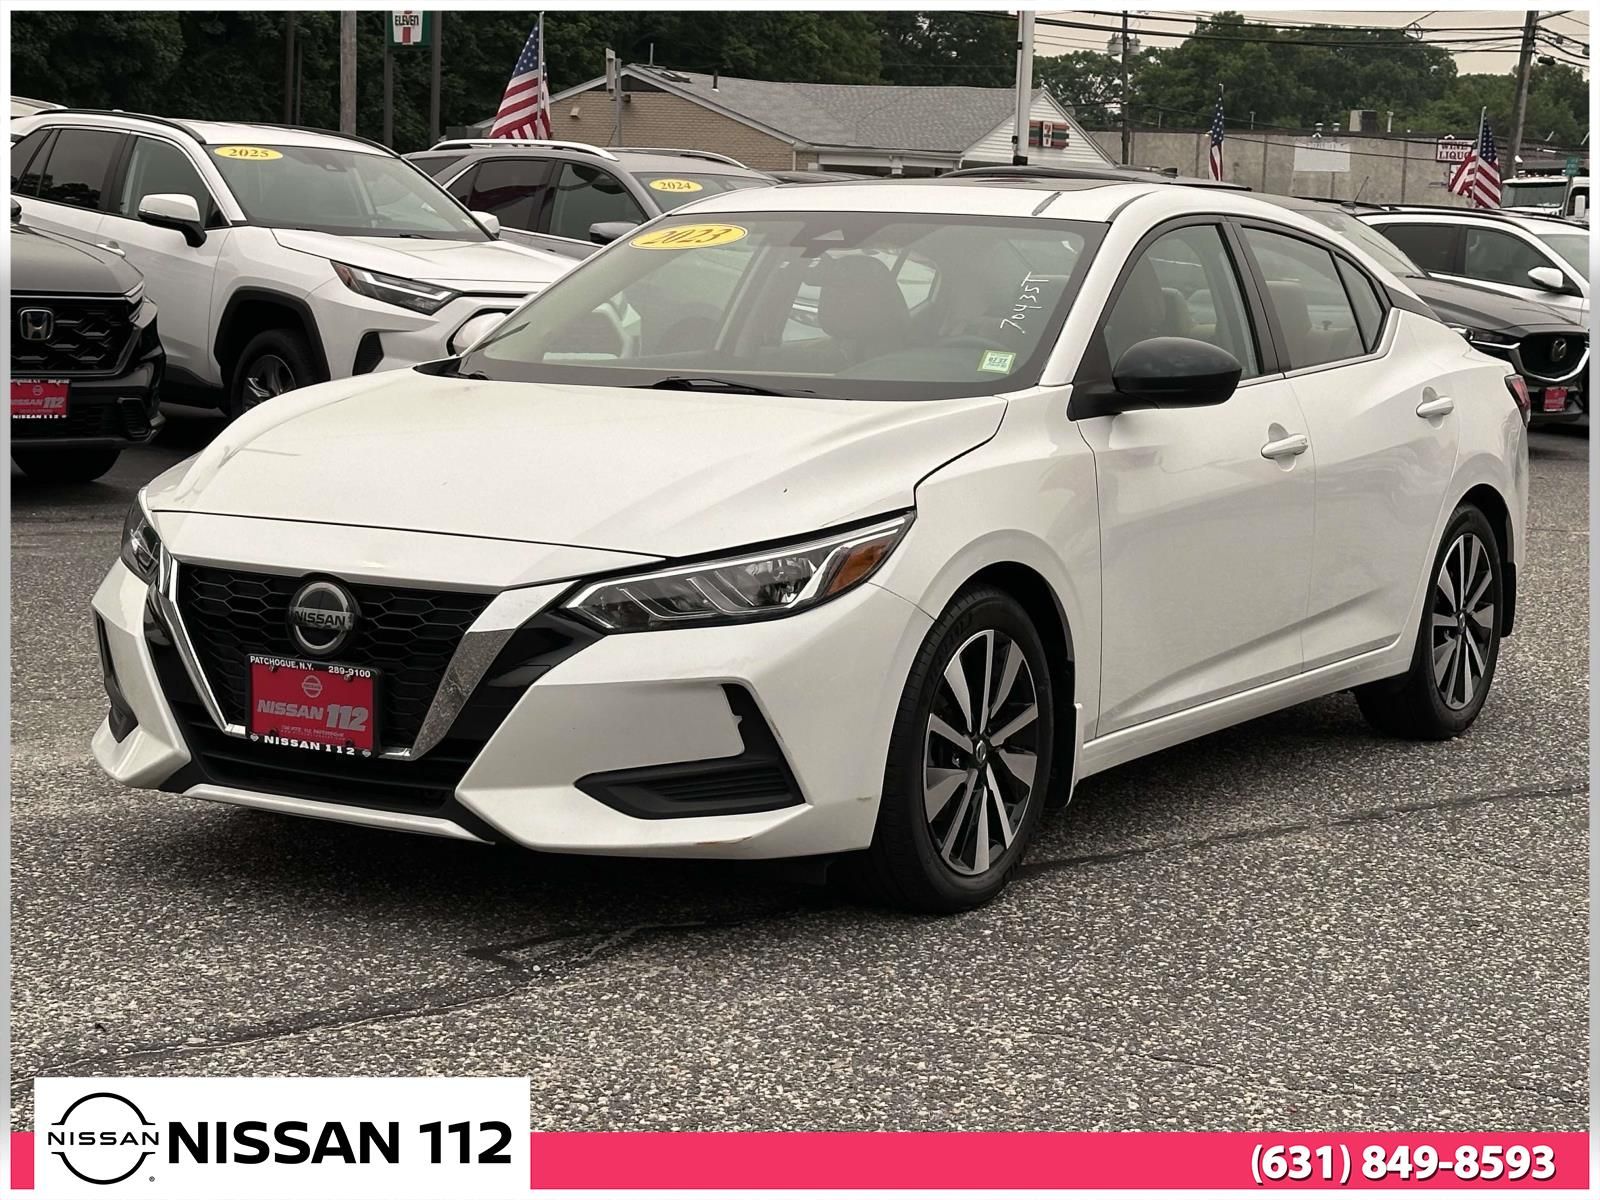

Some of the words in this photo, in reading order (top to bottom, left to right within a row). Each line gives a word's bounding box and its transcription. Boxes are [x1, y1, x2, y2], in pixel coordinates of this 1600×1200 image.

[228, 148, 269, 158] 2025
[660, 181, 691, 190] 2024
[641, 228, 733, 244] 2023
[1000, 271, 1049, 334] 70435T
[294, 609, 346, 627] NISSAN
[328, 665, 371, 678] 289-9100
[257, 699, 324, 720] NISSAN
[326, 704, 369, 732] 112
[264, 735, 320, 751] NISSAN
